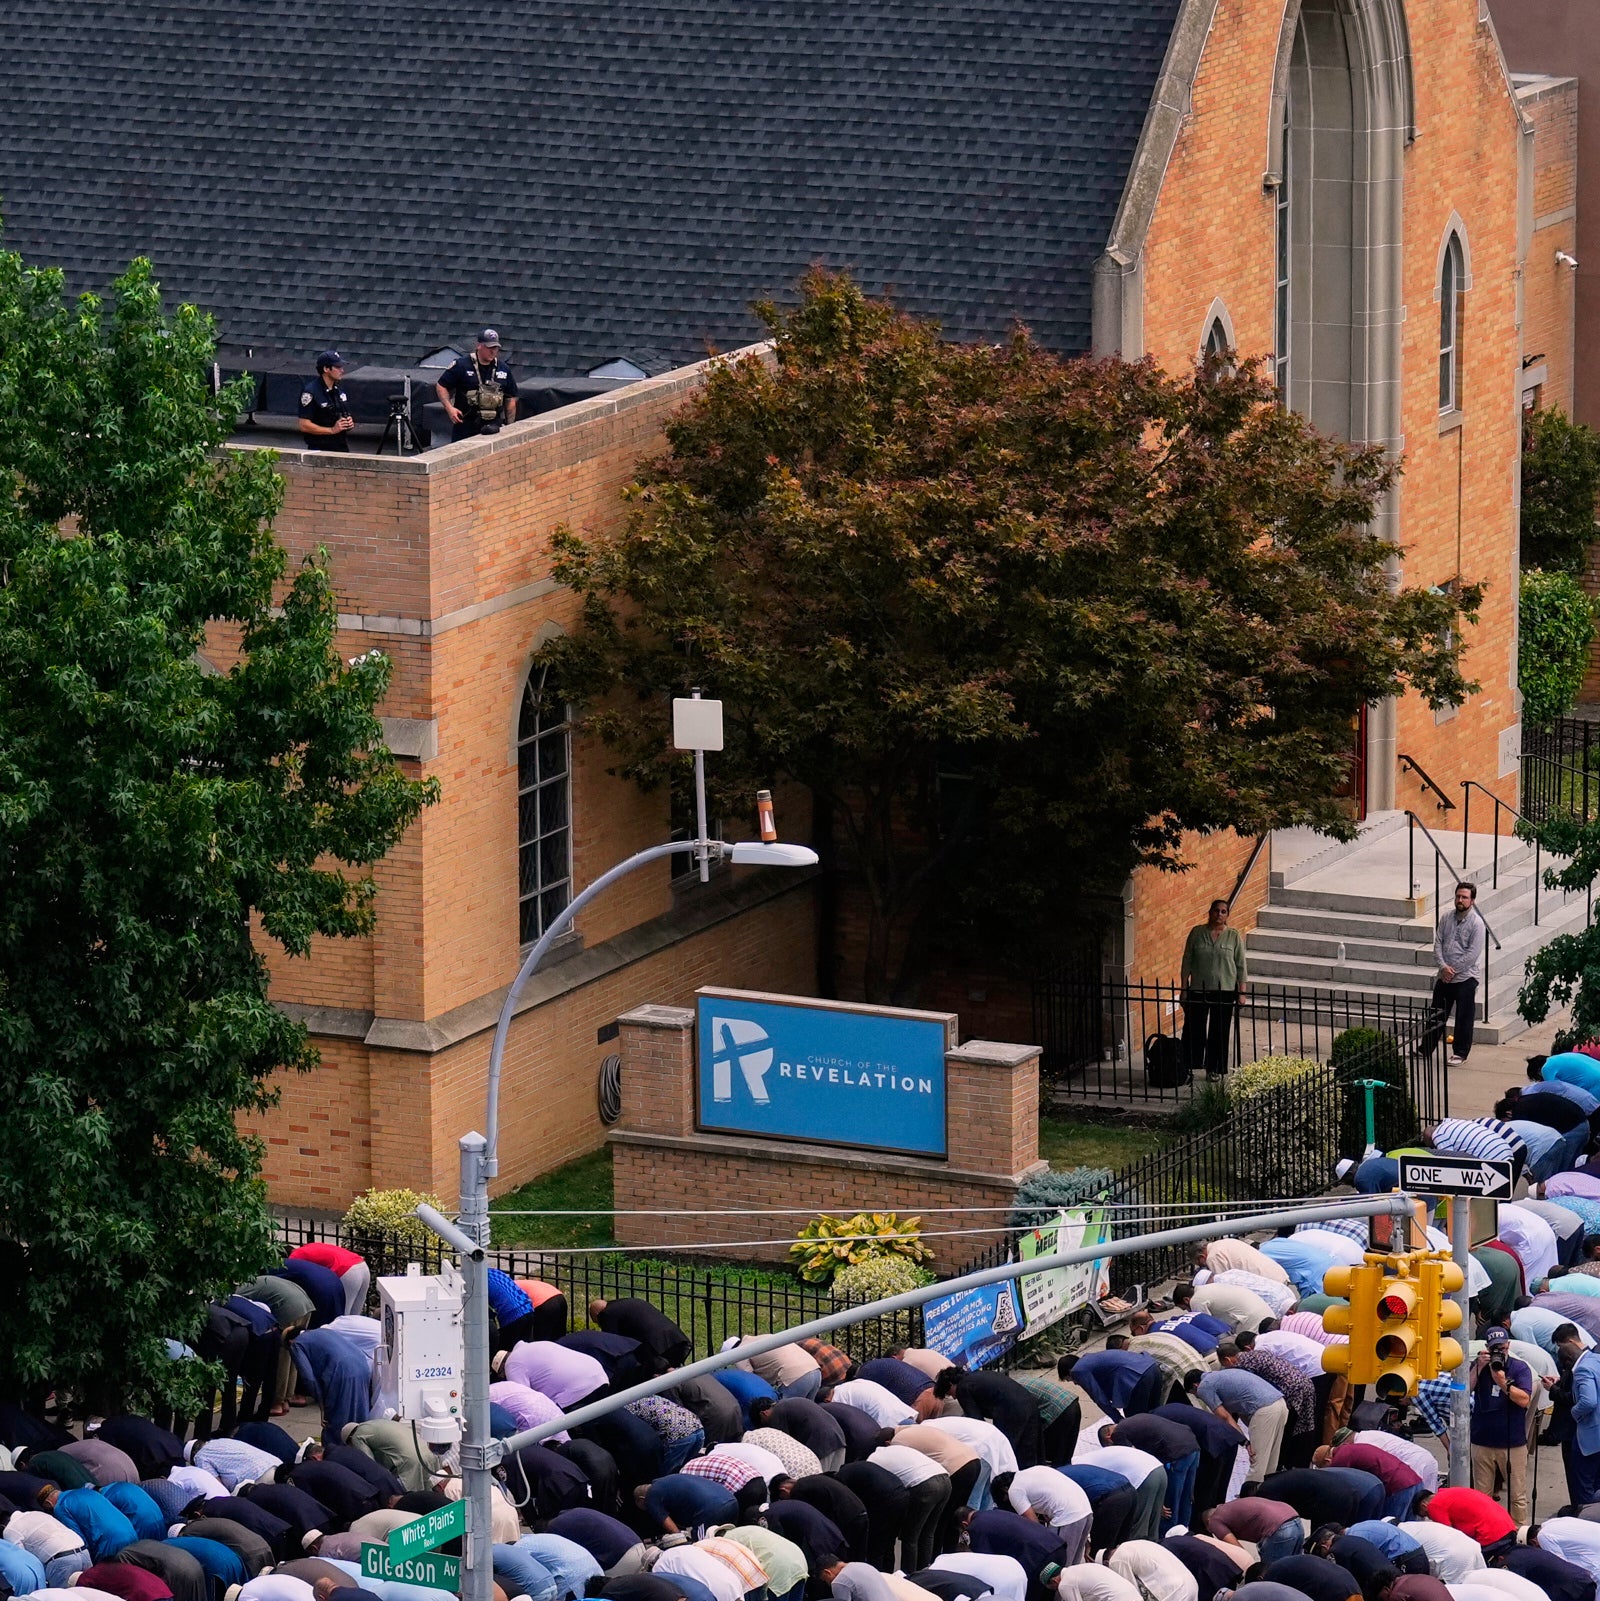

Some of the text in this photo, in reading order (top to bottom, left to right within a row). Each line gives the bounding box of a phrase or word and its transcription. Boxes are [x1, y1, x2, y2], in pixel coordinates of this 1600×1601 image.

[807, 1055, 898, 1073] CHURCH OF THE
[779, 1062, 932, 1094] REVELATION
[1410, 1167, 1496, 1187] ONE WAY
[415, 1366, 452, 1379] 3-22324
[401, 1510, 456, 1547] White Plains
[423, 1538, 435, 1549] Road
[443, 1563, 457, 1577] Av
